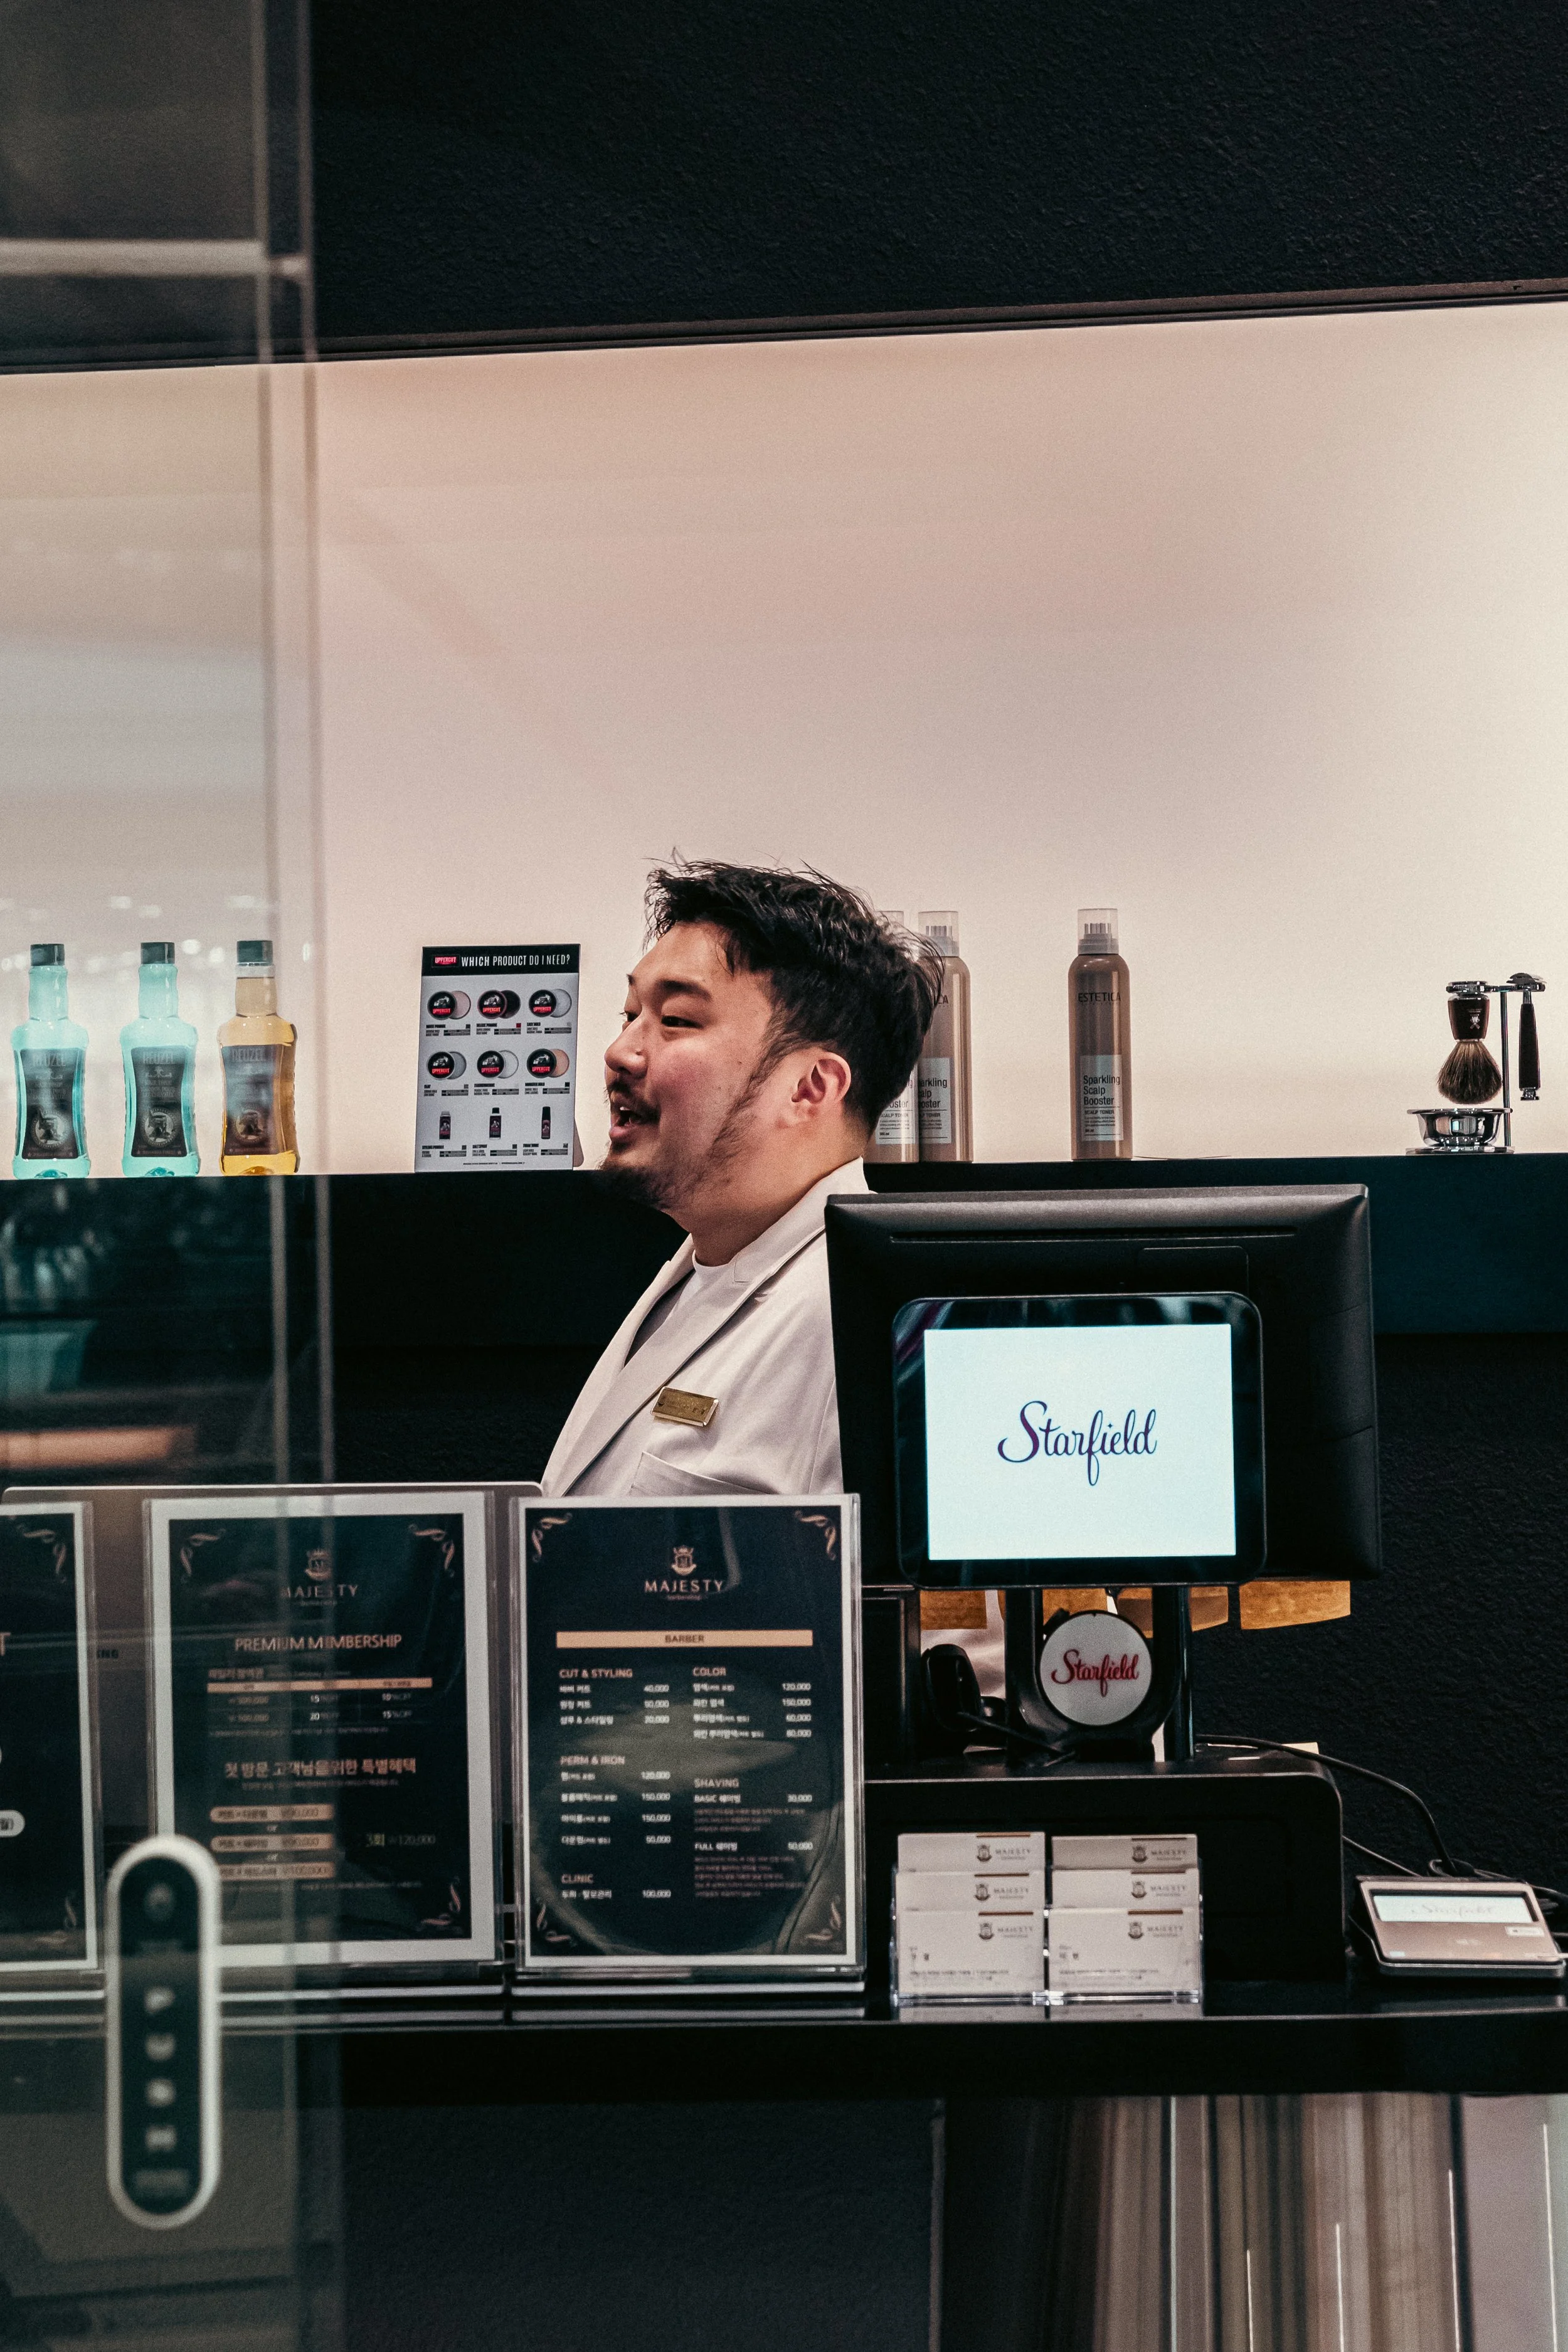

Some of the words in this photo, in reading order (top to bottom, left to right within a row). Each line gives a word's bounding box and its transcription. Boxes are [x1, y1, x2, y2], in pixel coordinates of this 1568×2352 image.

[435, 956, 457, 964] UPPERCUT
[461, 956, 490, 967] WHICH
[492, 955, 527, 966] PRODUCT
[529, 955, 539, 965] DO
[541, 955, 544, 965] I
[546, 954, 570, 965] NEED?
[1077, 992, 1121, 1003] ESTETICA
[918, 1078, 948, 1089] arkling
[1083, 1074, 1120, 1086] Sparkling
[1083, 1086, 1106, 1096] Scalp
[1083, 1096, 1115, 1105] Booster
[998, 1401, 1157, 1486] Starfield
[644, 1580, 723, 1593] MAJESTY
[235, 1636, 305, 1651] PREMIUM
[665, 1634, 704, 1643] BARBER
[559, 1670, 579, 1678] CUT
[581, 1670, 589, 1678] &
[591, 1669, 633, 1678] STYLING
[692, 1667, 727, 1677] COLOR
[1051, 1649, 1139, 1697] Starfield
[241, 1761, 269, 1778] 방문
[694, 1777, 739, 1788] SHAVING
[694, 1794, 717, 1803] BASIC
[694, 1842, 713, 1851] FULL
[561, 1874, 594, 1884] CLINIC
